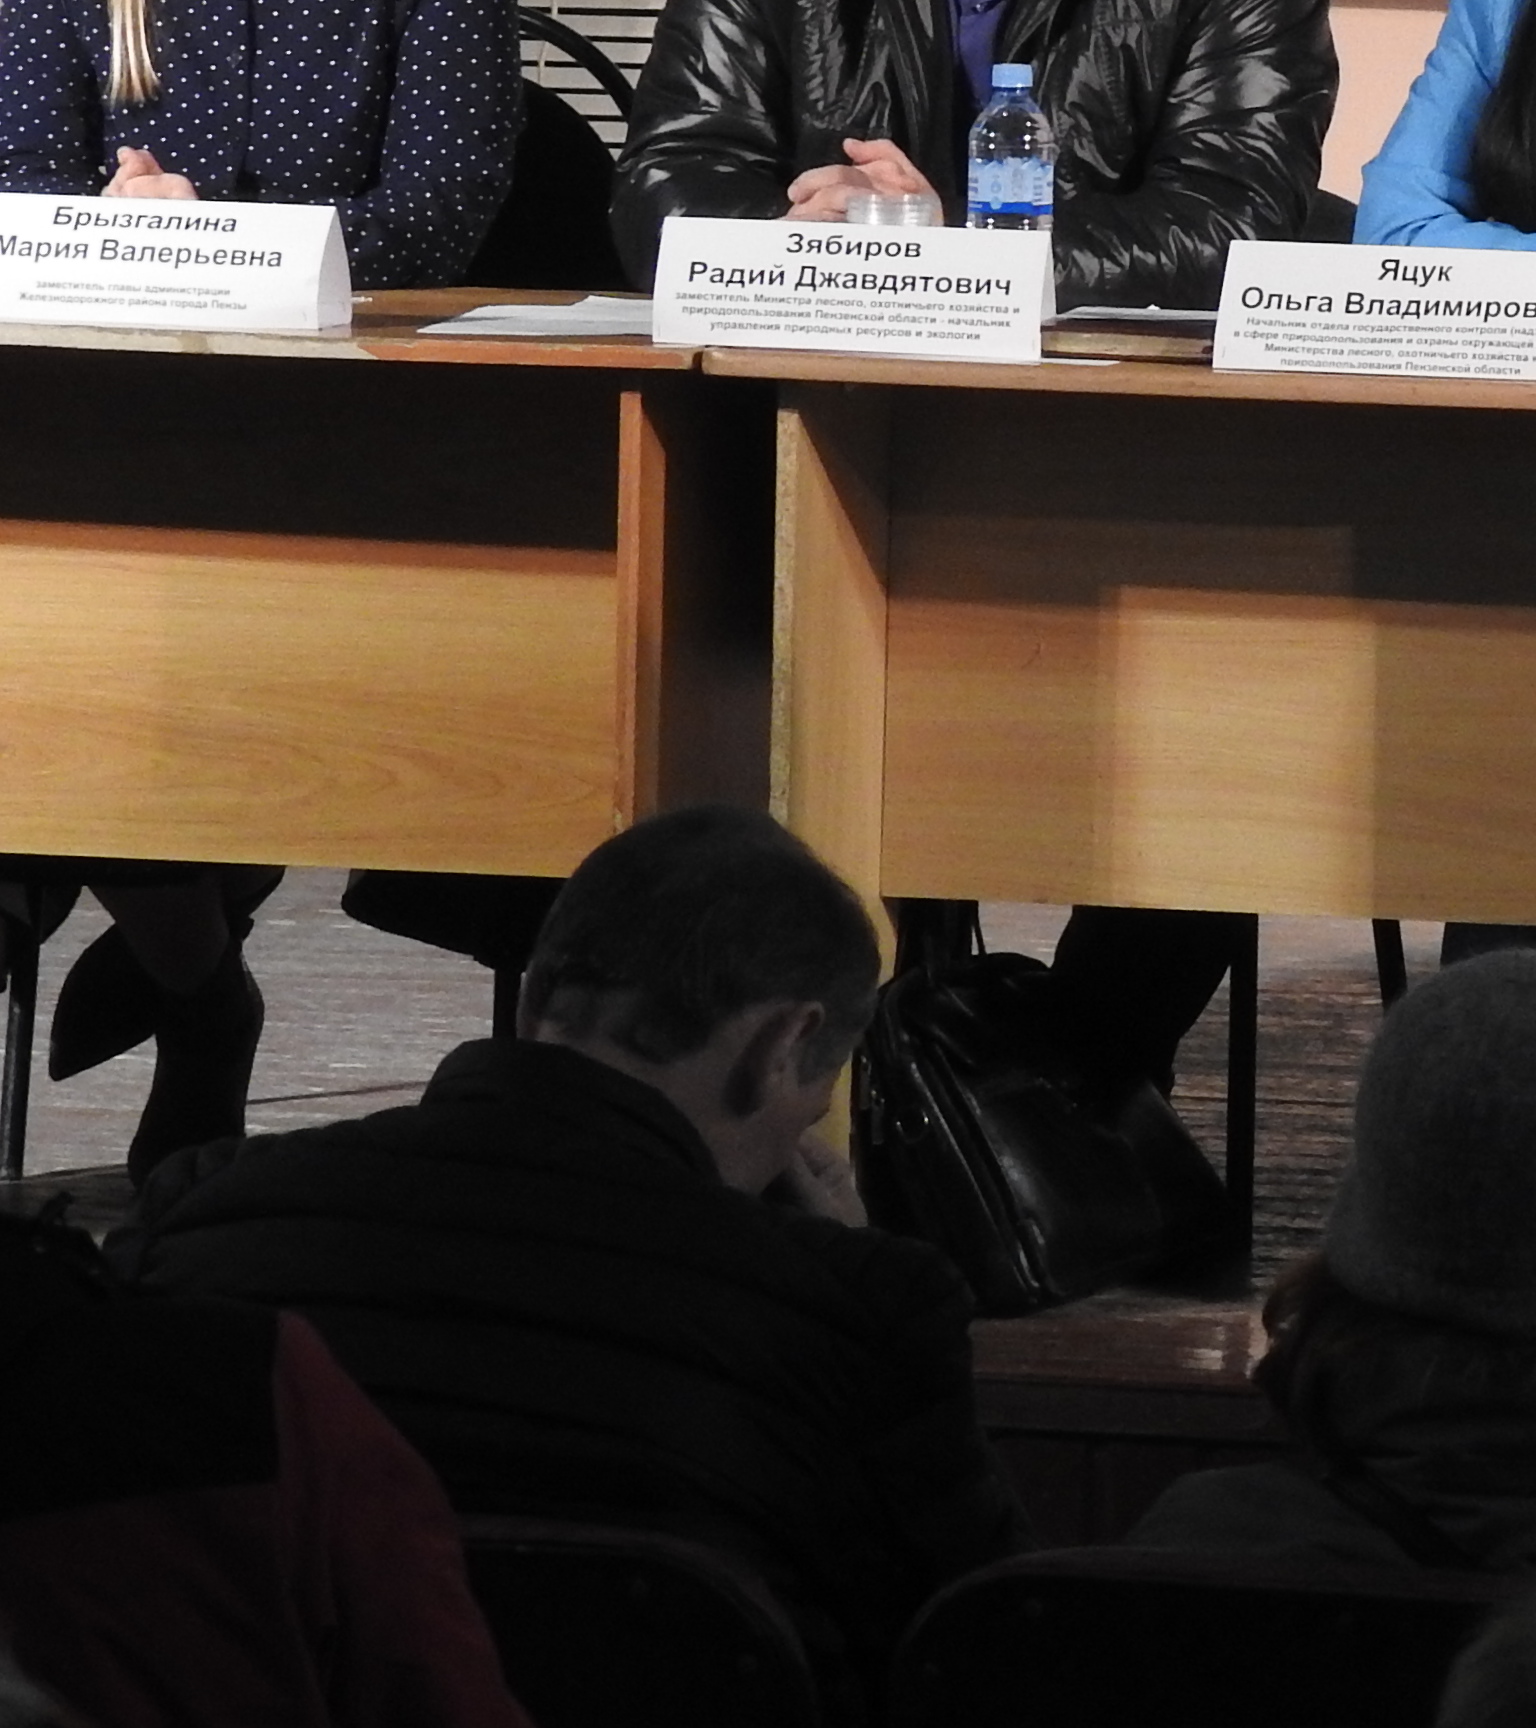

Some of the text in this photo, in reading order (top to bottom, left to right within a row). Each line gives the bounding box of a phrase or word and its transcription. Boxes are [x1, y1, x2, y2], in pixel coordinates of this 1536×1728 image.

[53, 206, 238, 233] Брызгалина
[0, 235, 283, 269] Мария Валерьевна
[786, 233, 922, 261] Зябиров
[688, 261, 1012, 296] Радий Джавдятович
[1378, 259, 1453, 287] Яцук
[36, 280, 231, 297] заместитель главы администрации
[19, 291, 247, 310] Железнодорожного района города Пензы
[675, 291, 1020, 314] заместитель Министра лесного, охотничьего хозяйства и
[1241, 287, 1333, 314] Ольга
[682, 304, 812, 319] природопользования
[815, 309, 884, 322] Пензенской
[888, 312, 937, 324] области
[948, 317, 1011, 328] начальник
[1246, 317, 1307, 328] Начальник
[1311, 321, 1349, 331] отдела
[1352, 323, 1452, 333] государственного
[1455, 326, 1507, 335] контроля
[710, 321, 781, 332] управления
[784, 324, 852, 335] природных
[856, 326, 912, 338] ресурсов
[926, 330, 981, 340] экологии
[1233, 330, 1240, 338] в
[1243, 330, 1279, 341] сфере
[1282, 333, 1403, 345] природопользования
[1416, 338, 1458, 348] охраны
[1461, 339, 1534, 350] окружающей
[1264, 343, 1344, 356] Министерства
[1347, 348, 1395, 358] лесного,
[1398, 349, 1468, 360] охотничьего
[1471, 352, 1529, 362] хозяйства
[1280, 358, 1521, 375] природопользования Пензенской области
